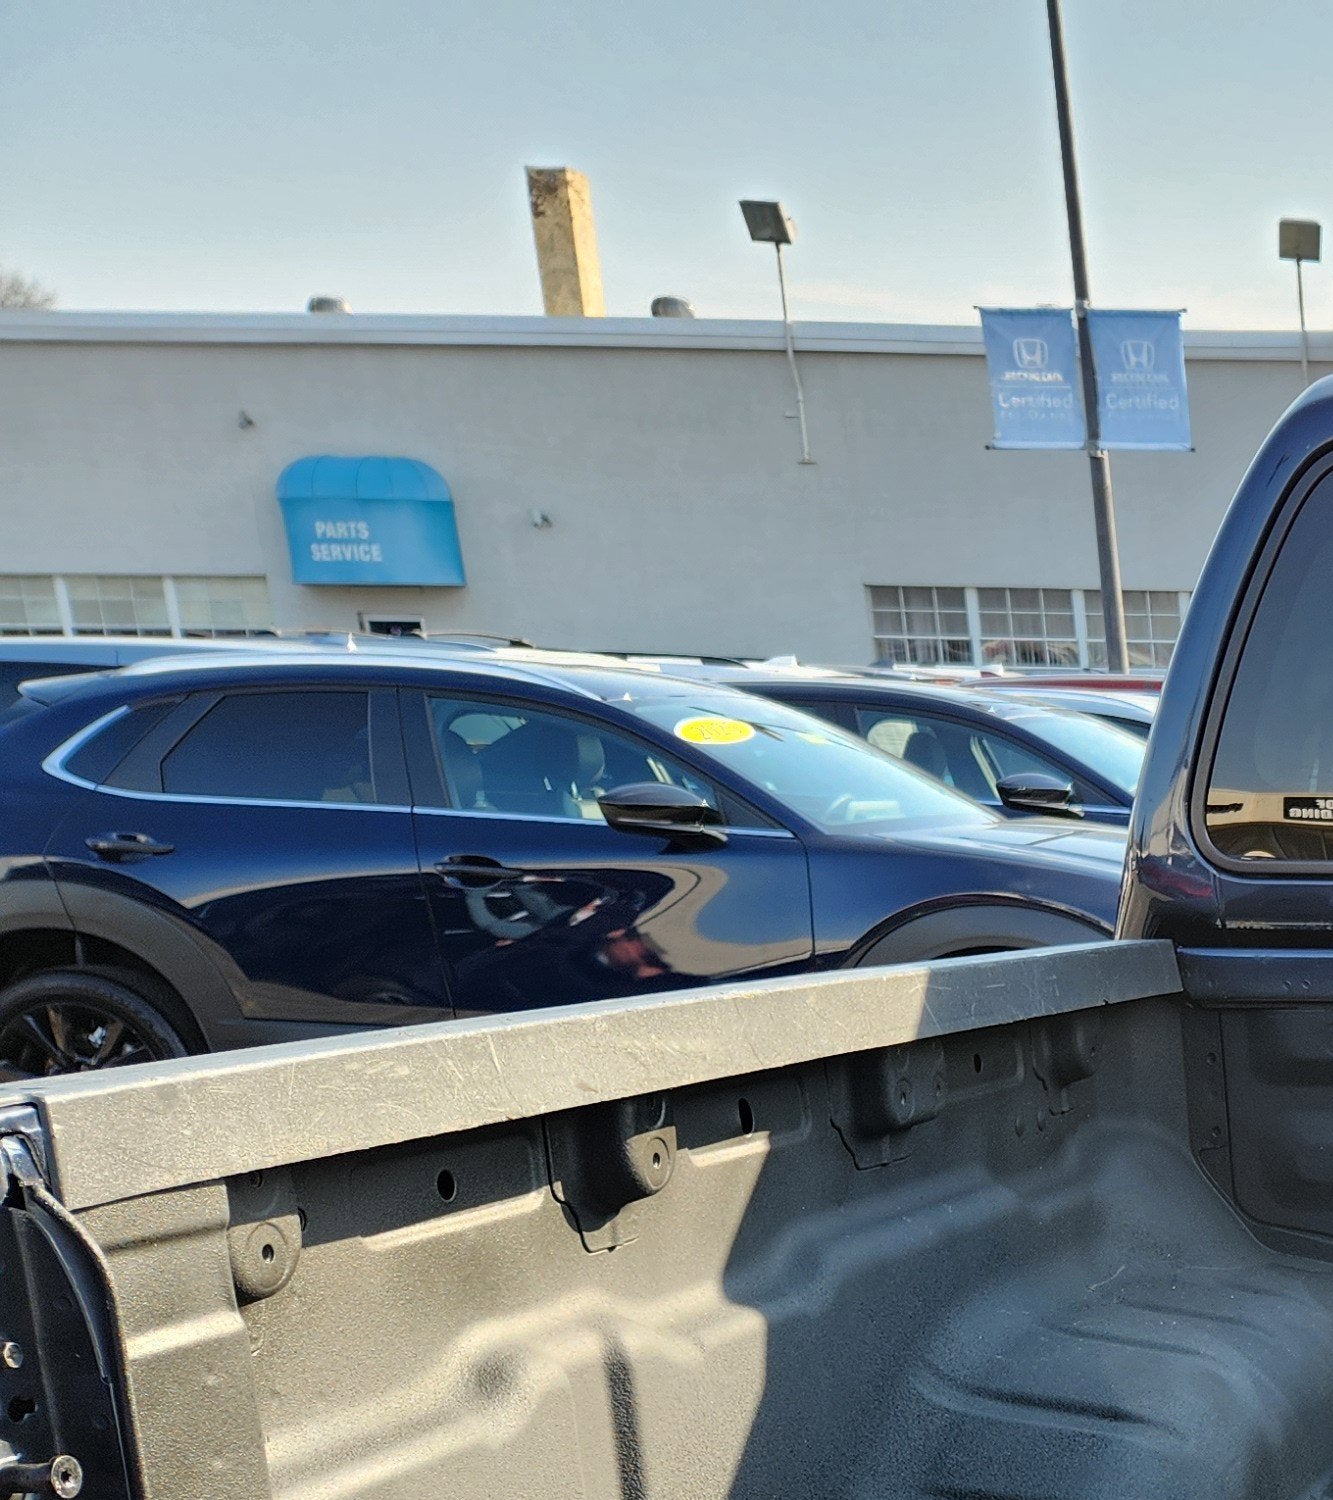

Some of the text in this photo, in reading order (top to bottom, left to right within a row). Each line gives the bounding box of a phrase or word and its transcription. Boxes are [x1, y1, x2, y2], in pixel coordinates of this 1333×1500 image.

[999, 392, 1073, 409] Certified
[1106, 392, 1179, 410] Certified
[314, 520, 369, 539] PARTS
[310, 542, 382, 562] SERVICE
